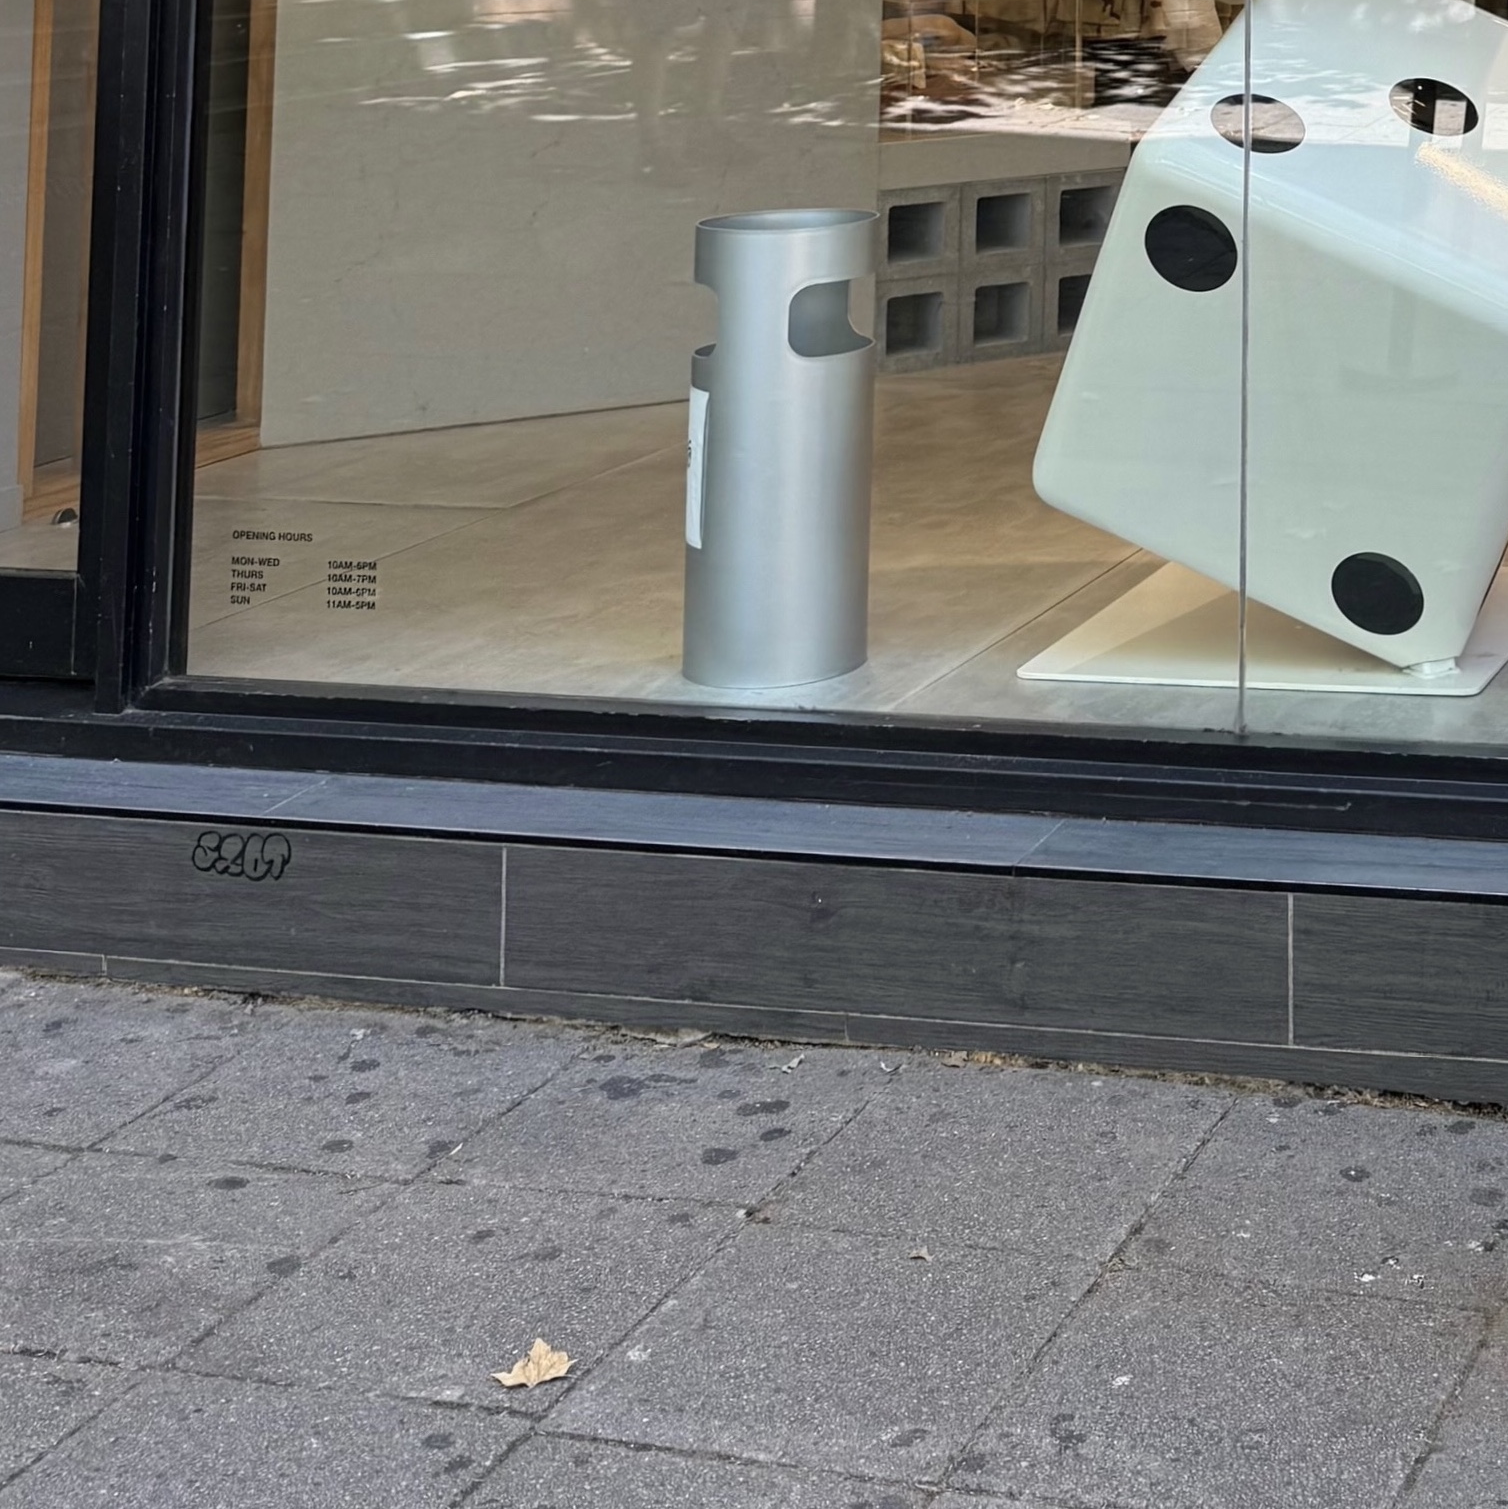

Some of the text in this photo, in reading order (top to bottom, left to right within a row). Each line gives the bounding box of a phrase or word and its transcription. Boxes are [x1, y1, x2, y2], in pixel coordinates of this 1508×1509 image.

[232, 530, 313, 542] OPENING HOURS
[231, 556, 377, 571] MON-WED 10AM-6PM
[231, 569, 377, 584] THURS 10AM-7PM
[230, 582, 267, 592] FRI-SAT
[230, 595, 376, 610] SUN 11AM-5PM
